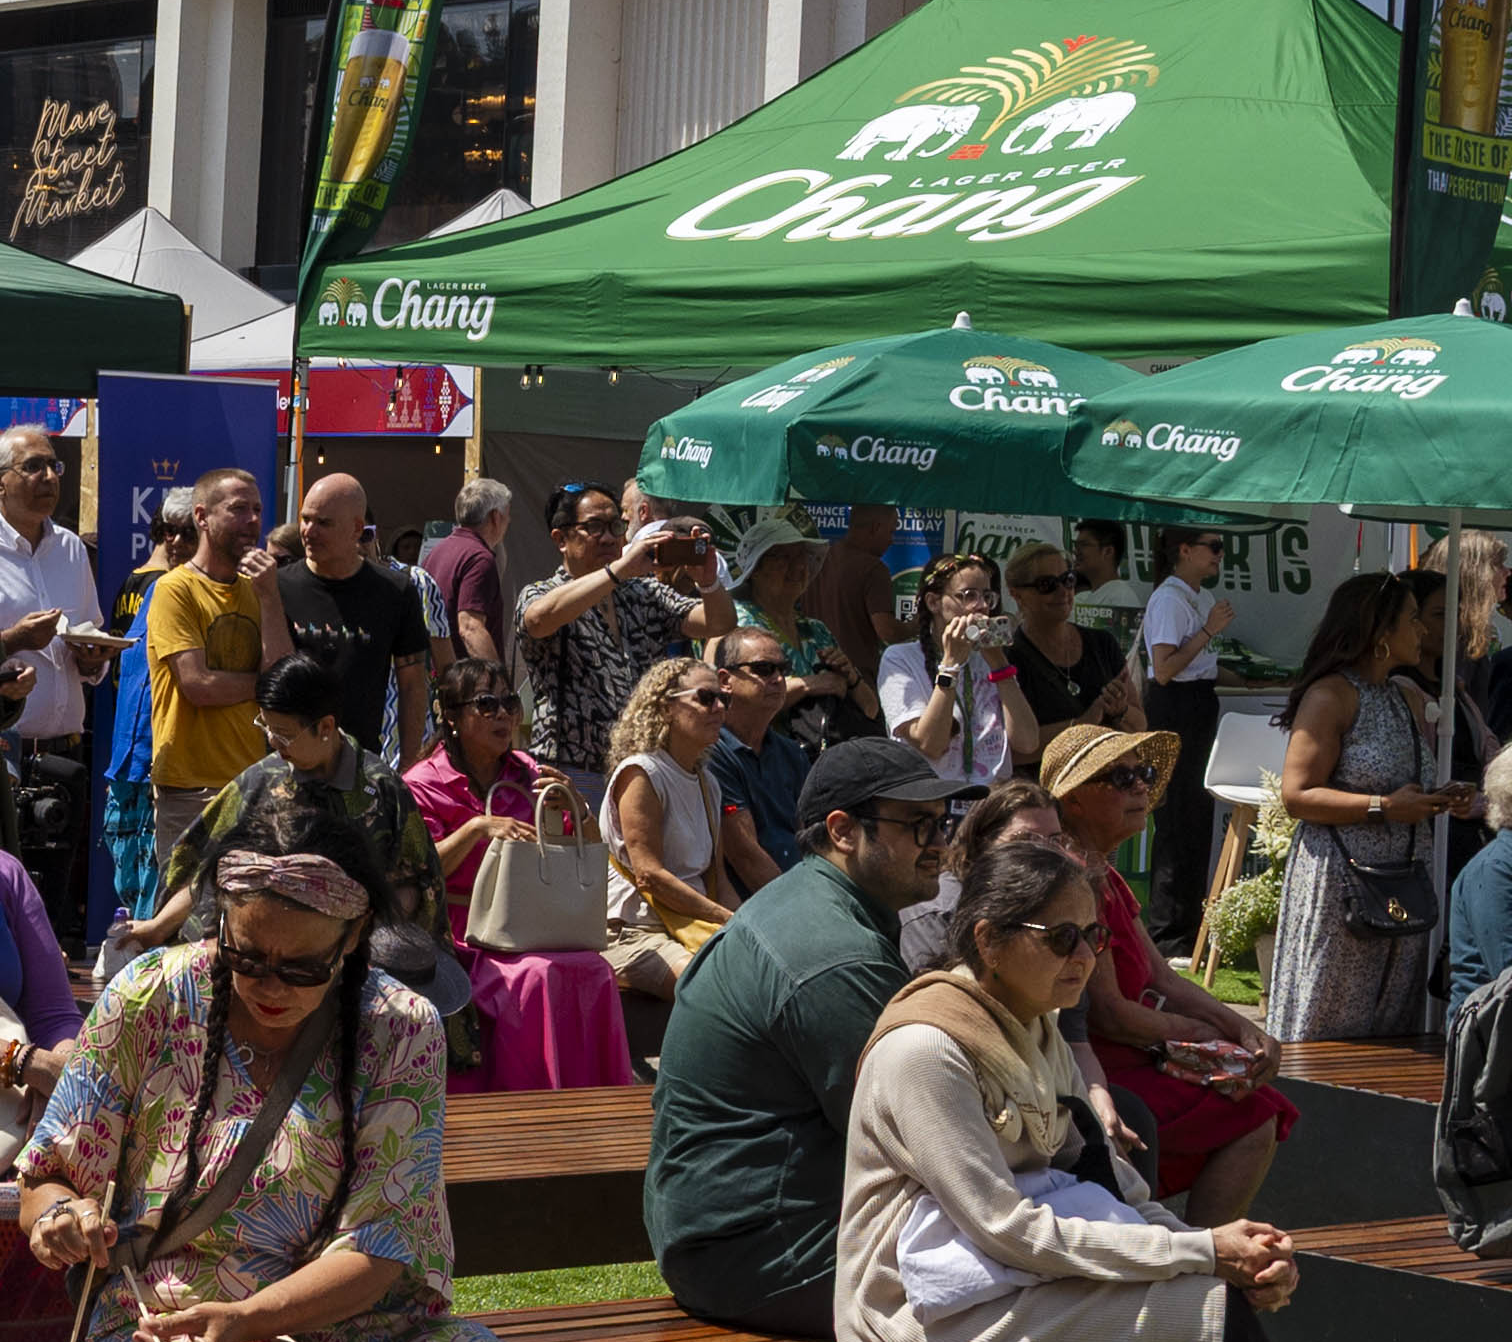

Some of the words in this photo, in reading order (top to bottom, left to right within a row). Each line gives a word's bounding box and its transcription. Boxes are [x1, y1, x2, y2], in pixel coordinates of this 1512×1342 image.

[1448, 8, 1493, 40] Chang
[32, 99, 110, 153] Mare
[33, 111, 117, 189] Street
[1429, 131, 1452, 159] THE
[1490, 142, 1509, 170] OF
[909, 170, 1023, 188] LAGER
[1031, 158, 1127, 179] BEER
[1449, 173, 1505, 204] PERFECTION
[10, 162, 125, 241] Market
[318, 185, 337, 205] THE
[664, 169, 1145, 242] Chang
[427, 282, 458, 291] LAGER
[461, 283, 487, 291] BEER
[372, 277, 496, 342] Chang
[1280, 365, 1450, 400] Chang
[676, 437, 712, 468] Chang
[851, 435, 938, 471] Chang
[1146, 423, 1241, 462] Chang
[807, 505, 846, 517] HANCE
[895, 519, 943, 532] OLIDAY
[1076, 607, 1113, 619] UNDER
